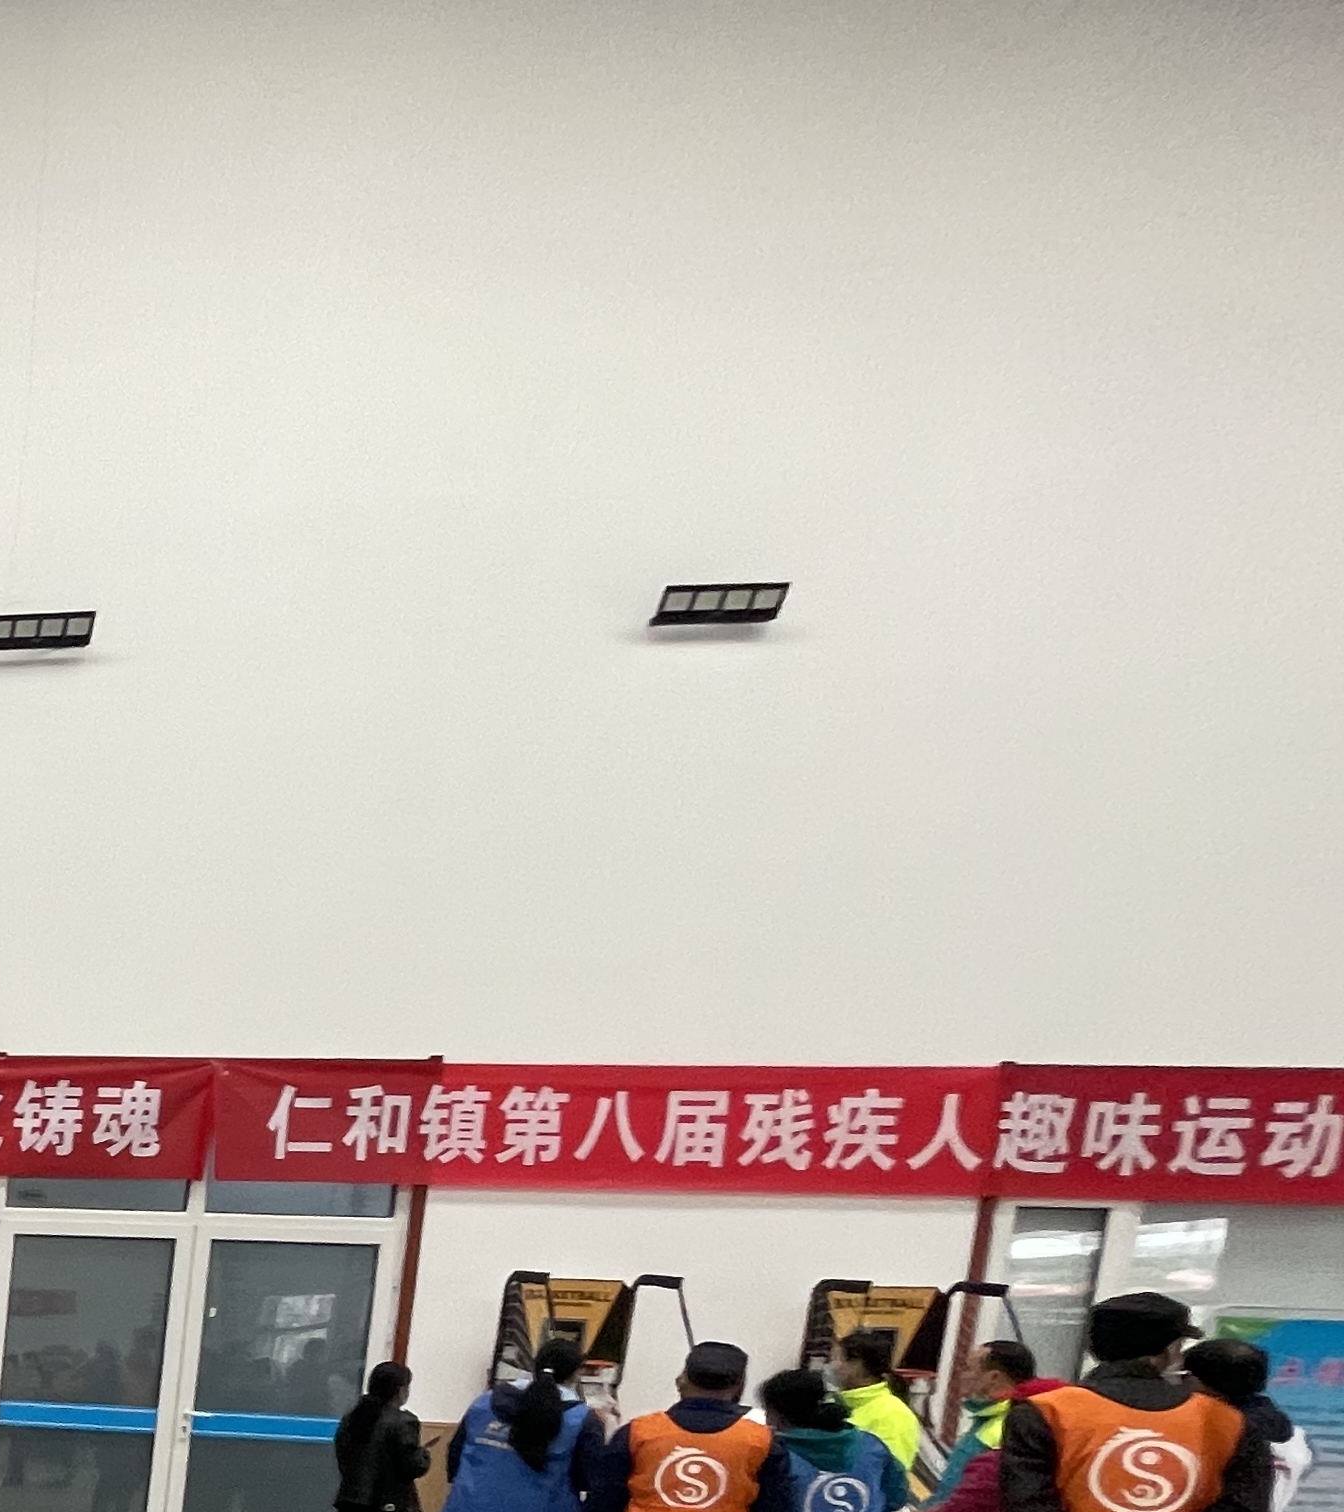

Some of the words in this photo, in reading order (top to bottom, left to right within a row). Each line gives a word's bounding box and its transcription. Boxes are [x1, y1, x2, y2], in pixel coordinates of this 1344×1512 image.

[266, 1084, 1344, 1179] 仁和镇第八届残疾人趣味运动
